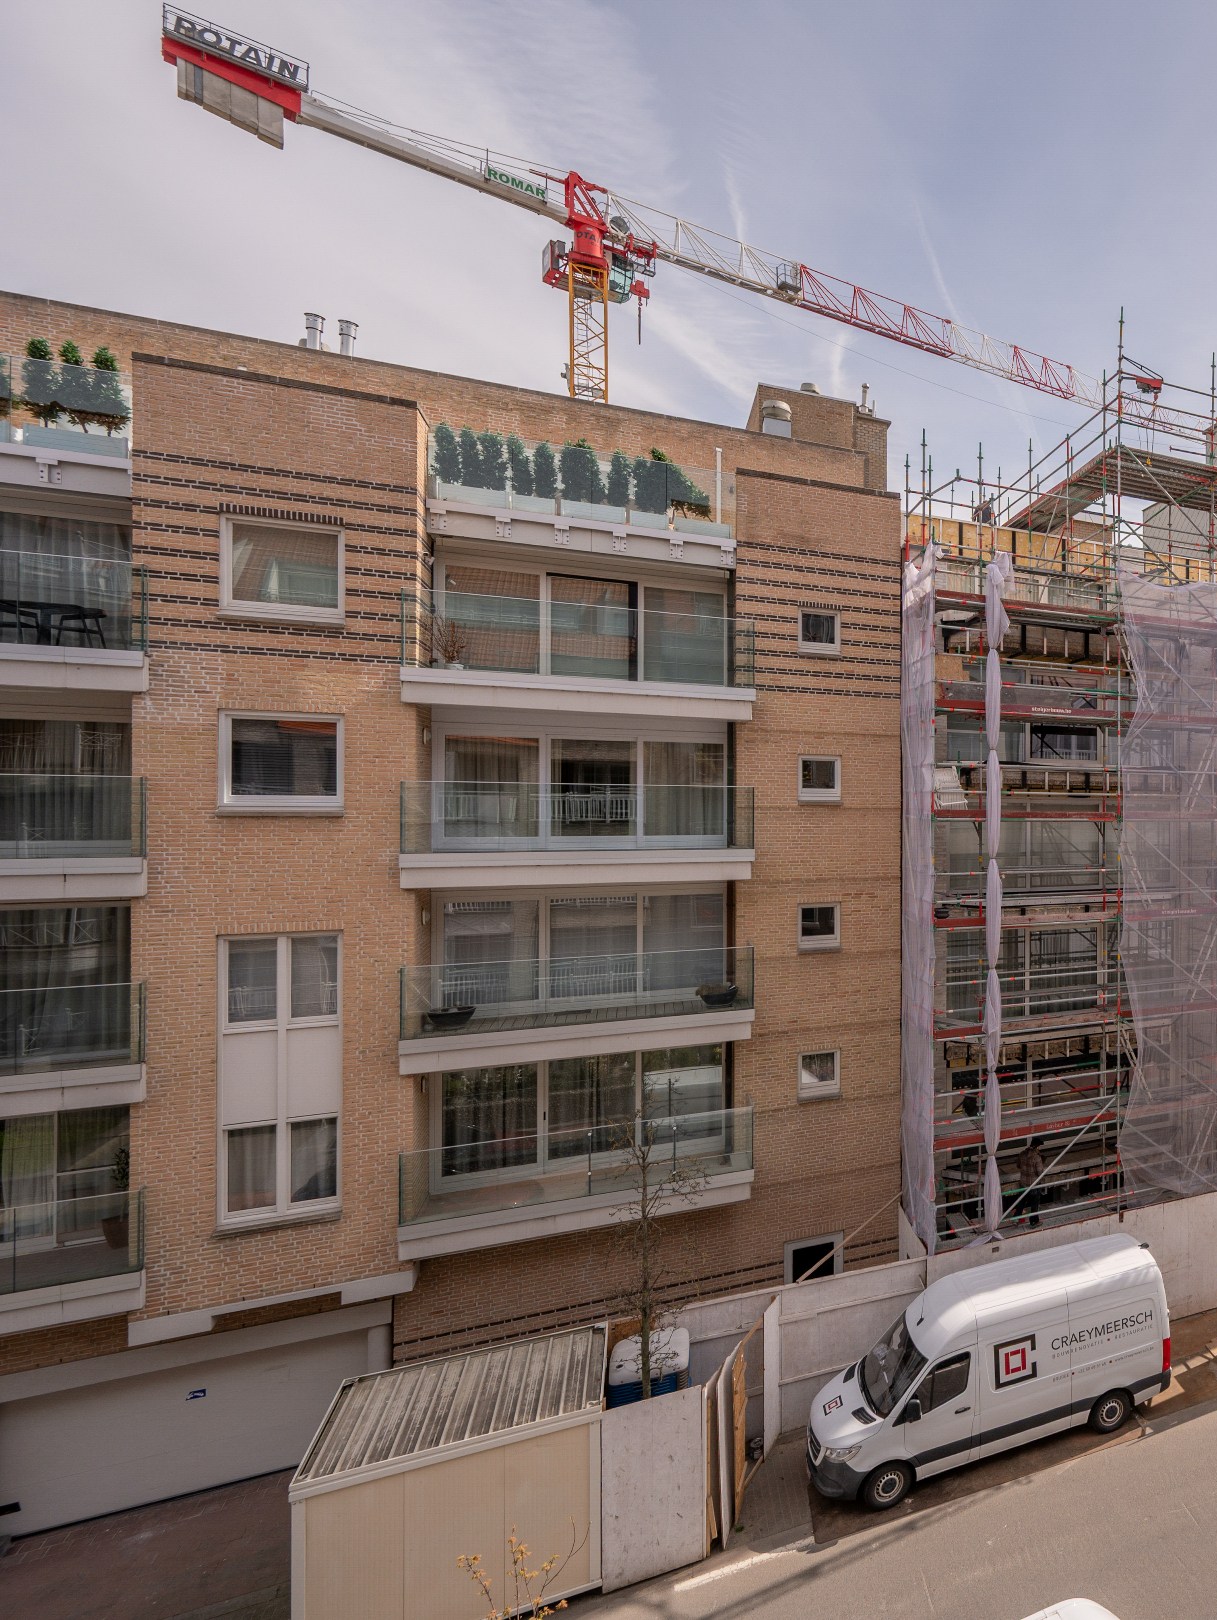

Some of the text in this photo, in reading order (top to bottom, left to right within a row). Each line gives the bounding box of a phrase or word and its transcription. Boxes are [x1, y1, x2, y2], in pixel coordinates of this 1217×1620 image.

[174, 16, 300, 81] POTAIN
[487, 166, 547, 199] ROMAR
[1051, 1310, 1153, 1350] CRAEYMEERSCH
[1114, 1324, 1153, 1340] RESTAURATIE
